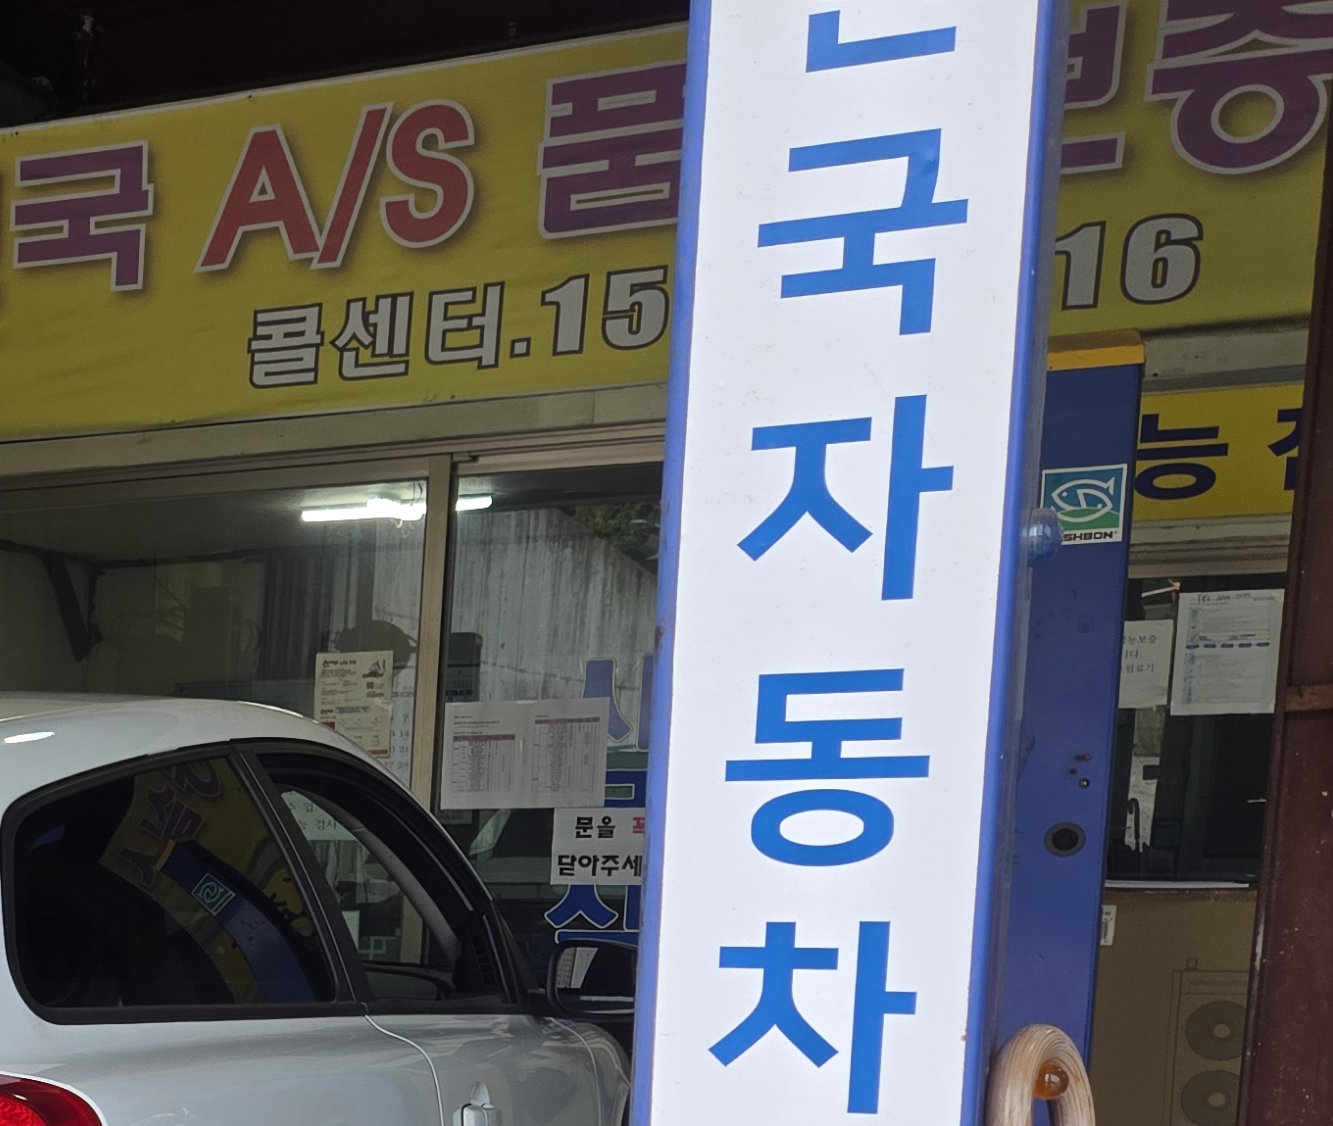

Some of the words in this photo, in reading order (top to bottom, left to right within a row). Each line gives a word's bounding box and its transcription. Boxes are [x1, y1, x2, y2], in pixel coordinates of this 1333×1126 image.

[193, 100, 477, 272] A/S
[575, 816, 616, 839] 문을
[557, 855, 643, 877] 닫아주세
